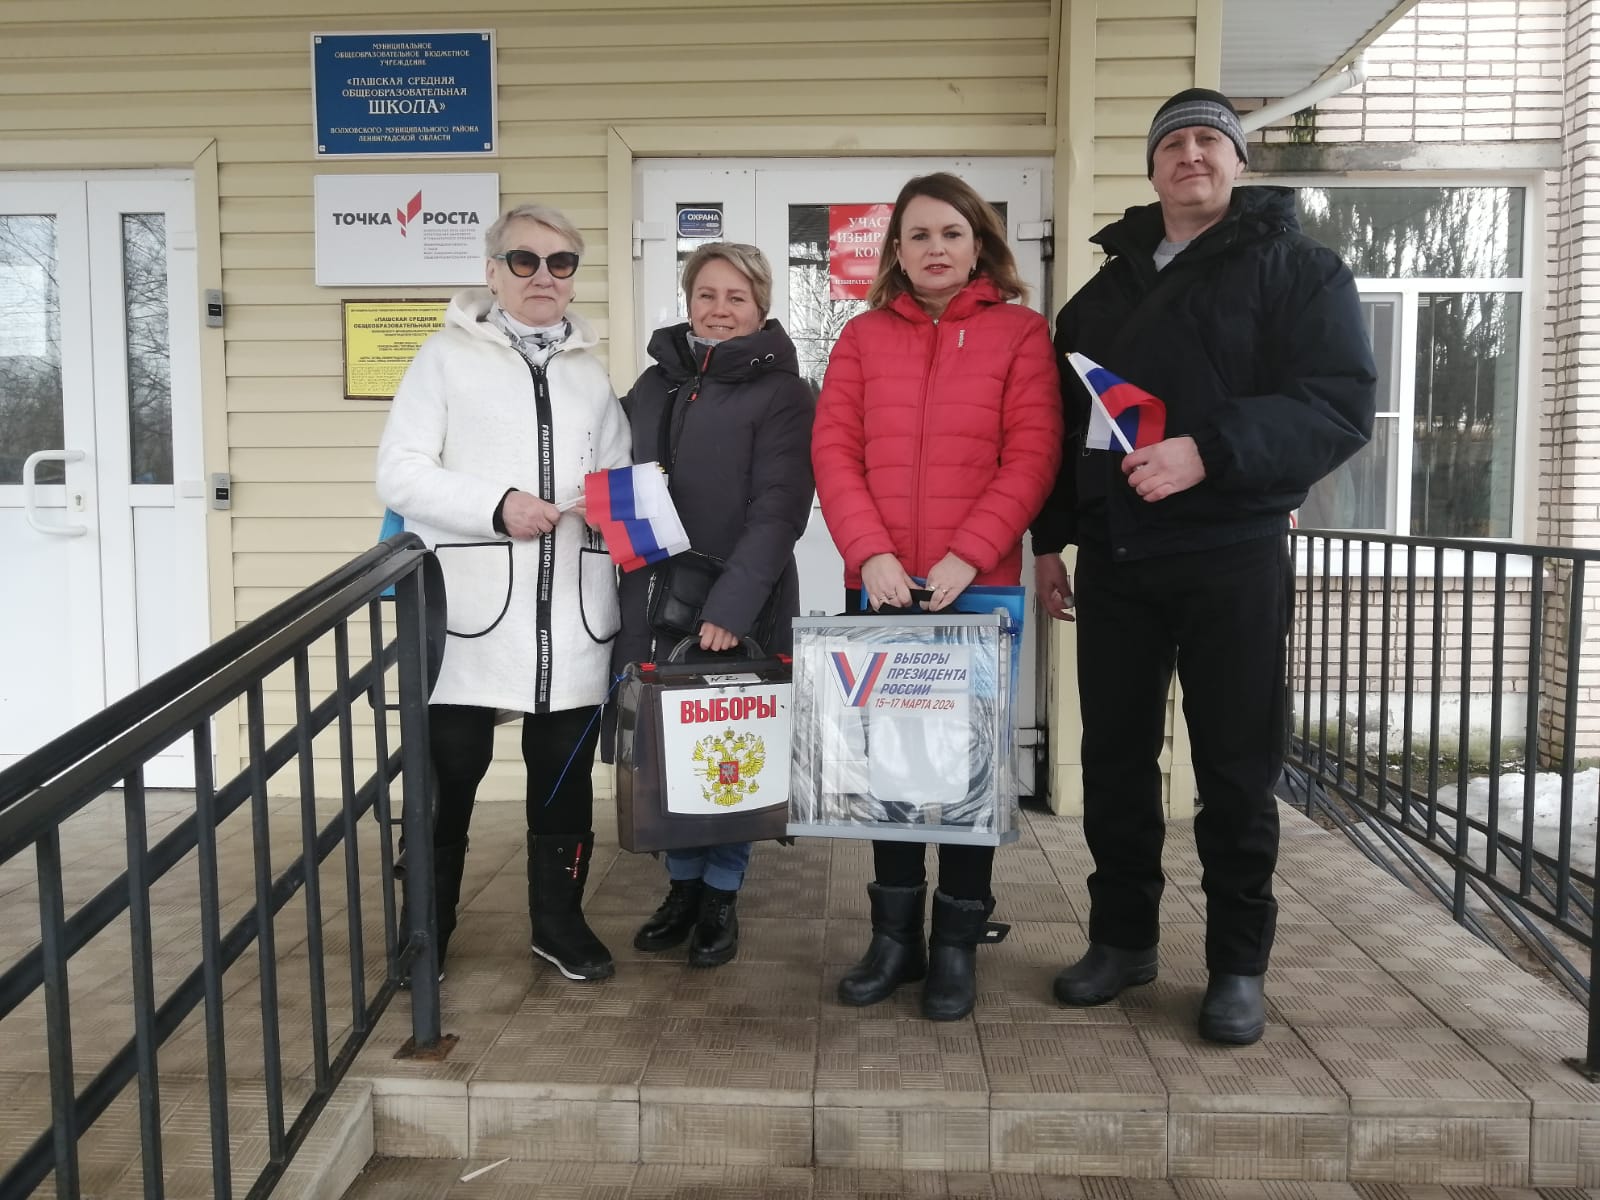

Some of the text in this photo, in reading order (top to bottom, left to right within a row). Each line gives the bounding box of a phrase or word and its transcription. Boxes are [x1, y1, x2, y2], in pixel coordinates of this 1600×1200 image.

[372, 42, 432, 50] МУНИЦИПАЛЬНОЕ
[334, 49, 470, 59] ОБЩЕОБРАЗОВАТЕЛЬНОЕ БЮДЖЕТНОЕ
[379, 58, 427, 66] УЧРЕЖДЕНИЕ
[346, 76, 455, 86] «ПАШСКАЯ СРЕДНЯЯ
[342, 87, 467, 98] ОБЩЕОБРАЗОВАТЕЛЬНАЯ
[368, 99, 446, 115] ШКОЛА»
[330, 124, 479, 134] ВОЛХОВСКОГО МУНИЦИПАЛЬНОГО РАЙОНА
[358, 134, 451, 142] ЛЕНИНГРАДСКОЙ ОБЛАСТИ
[332, 211, 480, 226] ТОЧКА РОСТА
[687, 213, 720, 221] ОХРАНА
[893, 652, 951, 665] ВЫБОРЫ
[886, 667, 967, 682] ПРЕЗИДЕНТА
[880, 683, 932, 696] РОССИИ
[680, 694, 777, 724] ВЫБОРЫ
[900, 699, 932, 710] МАРТА
[932, 699, 956, 710] 2024
